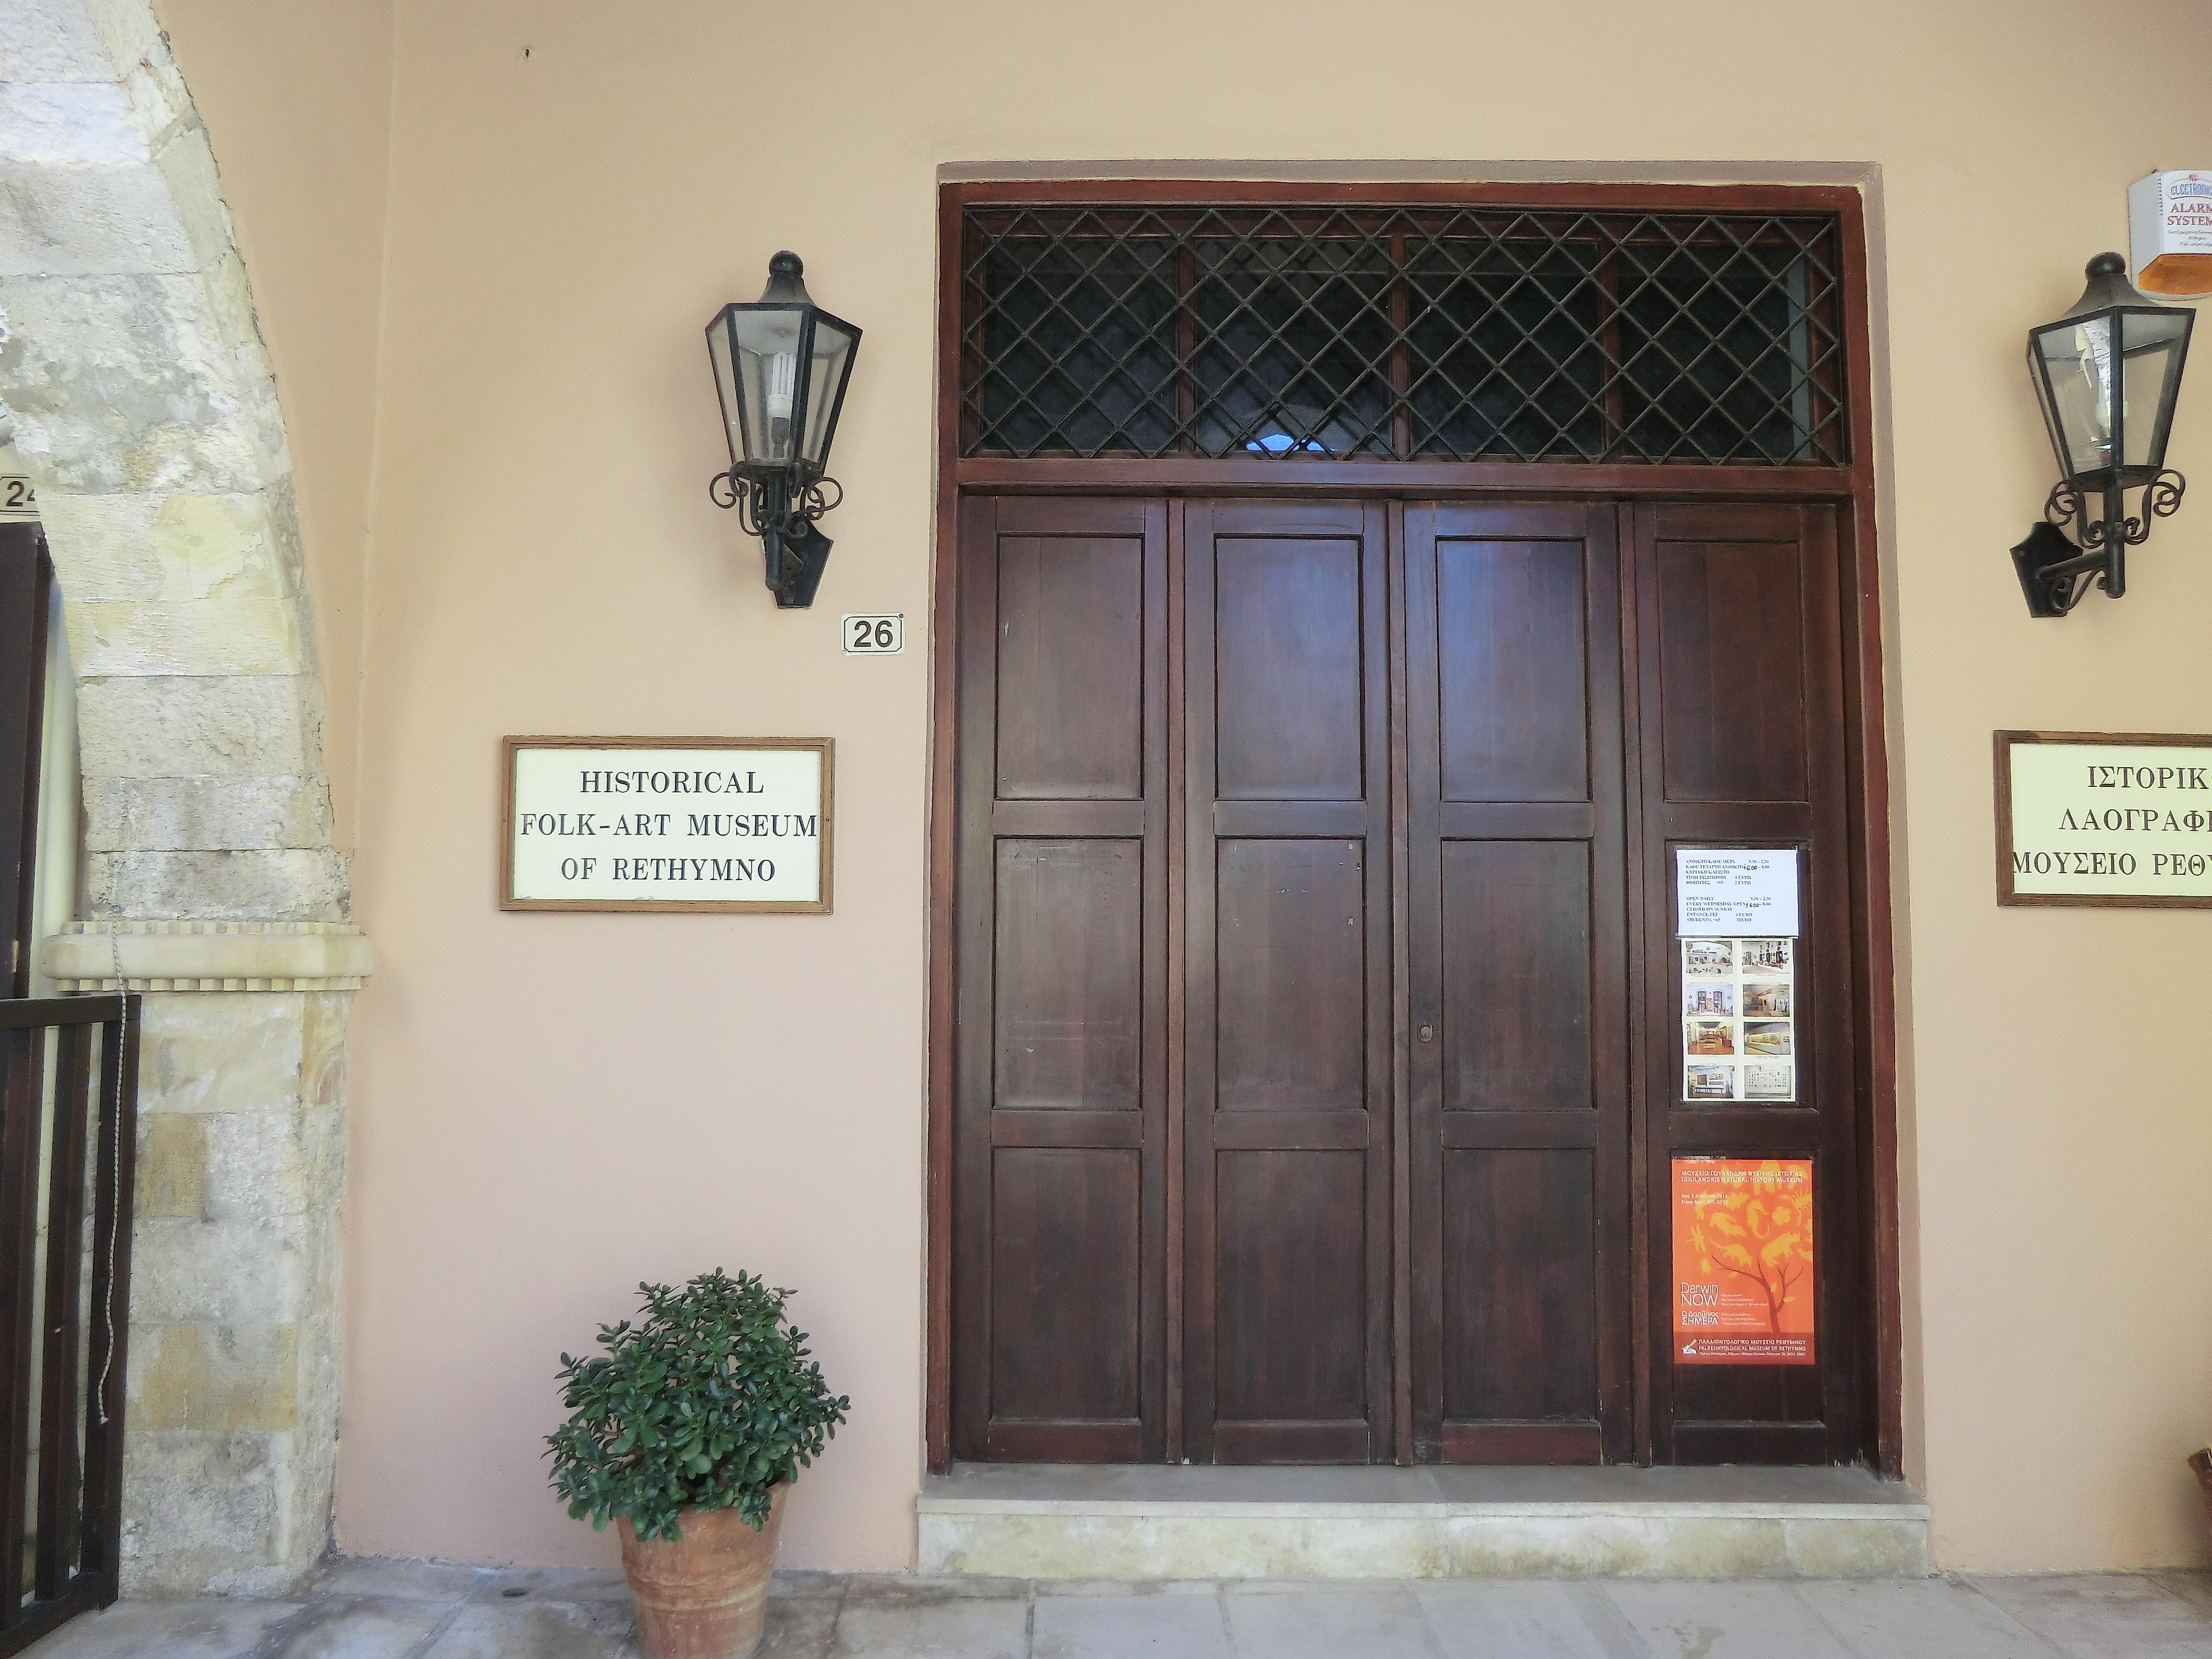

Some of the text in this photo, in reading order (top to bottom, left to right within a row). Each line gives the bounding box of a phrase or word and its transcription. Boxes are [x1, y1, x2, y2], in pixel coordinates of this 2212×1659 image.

[854, 620, 893, 648] 26
[580, 771, 764, 794] HISTORICAL
[2087, 766, 2212, 789] ΙΣΤΟΡΙΚ
[520, 813, 817, 837] FOLK-ART MUSEUM
[561, 858, 775, 881] OF RETHYMNO
[2013, 852, 2212, 876] ΜΟΥΣΕΙΟ ΡΕΘ
[1681, 1282, 1719, 1293] Darwin
[1682, 1294, 1718, 1306] NOW
[1682, 1317, 1718, 1325] ΣΗΜΕΡΑ
[1689, 1310, 1719, 1318] Δαρβίνος
